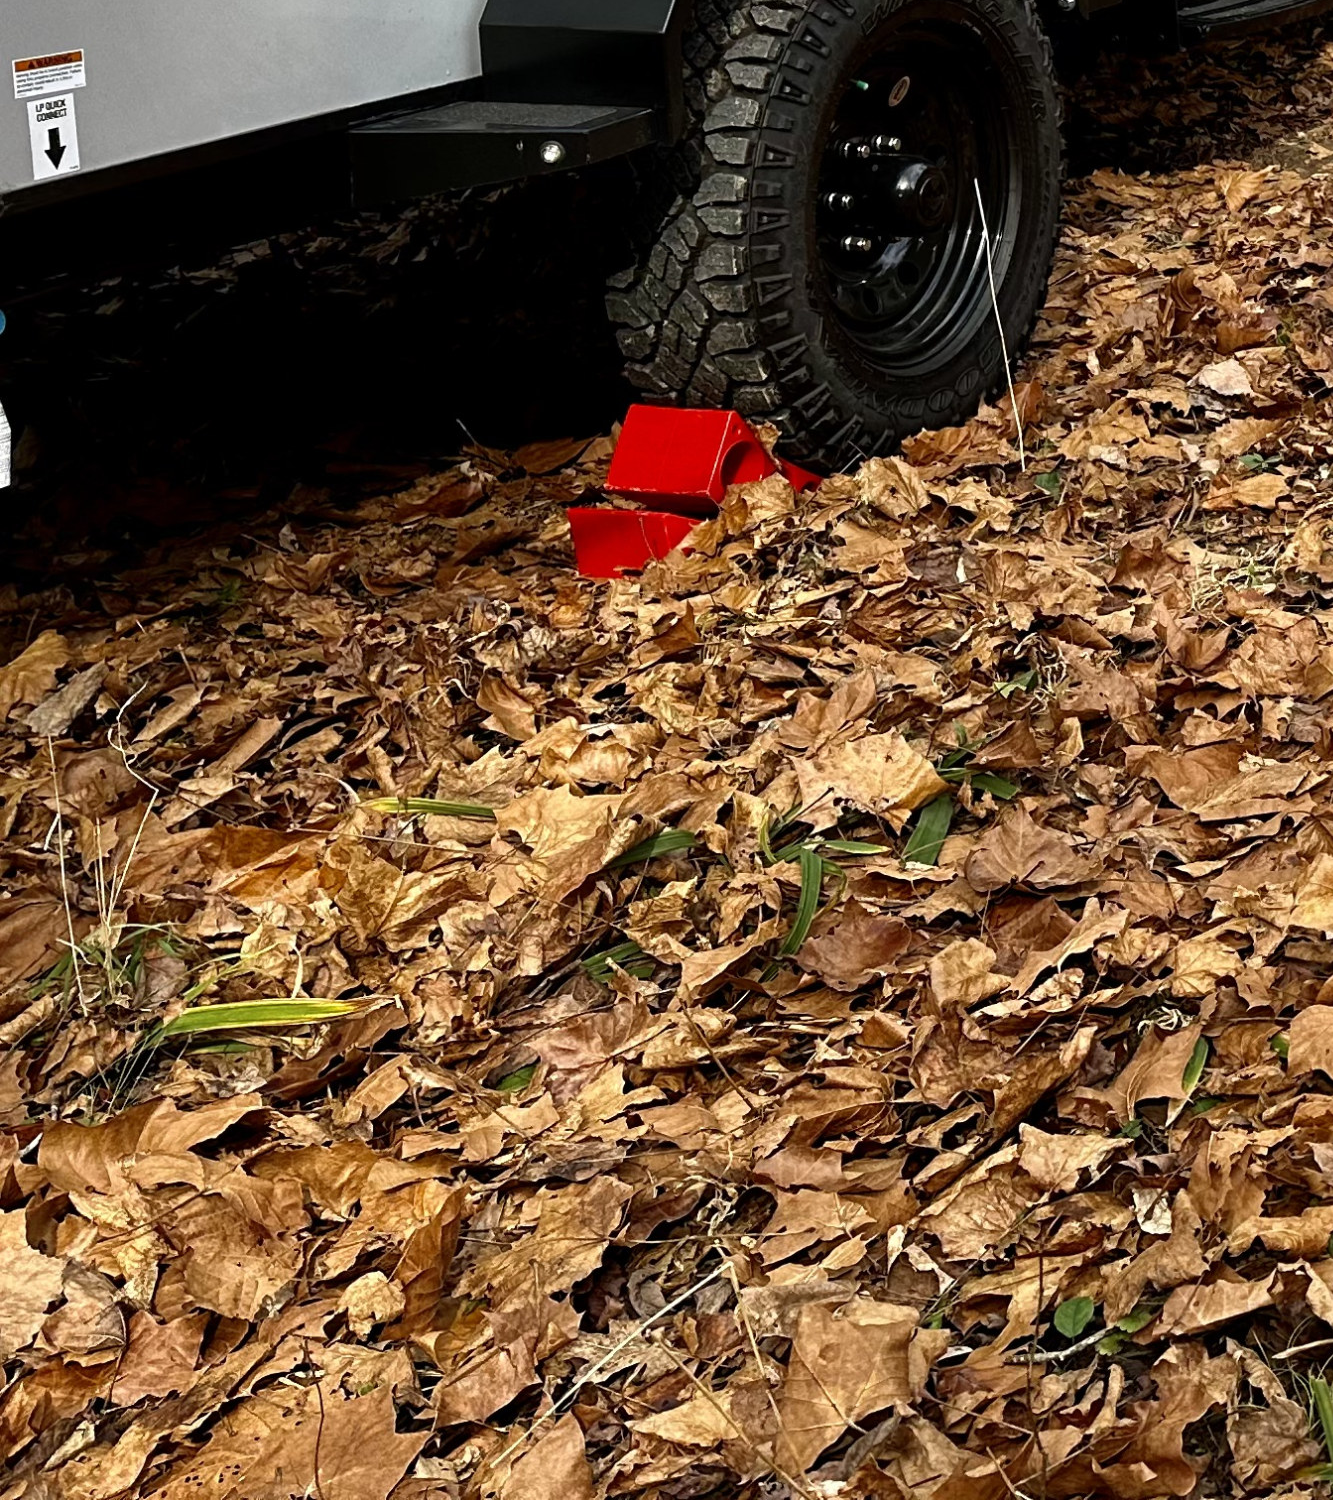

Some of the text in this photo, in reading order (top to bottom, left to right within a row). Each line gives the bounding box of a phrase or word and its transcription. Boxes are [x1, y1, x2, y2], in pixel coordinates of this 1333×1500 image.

[36, 99, 66, 112] LP QUICK
[37, 108, 67, 122] CONNECT
